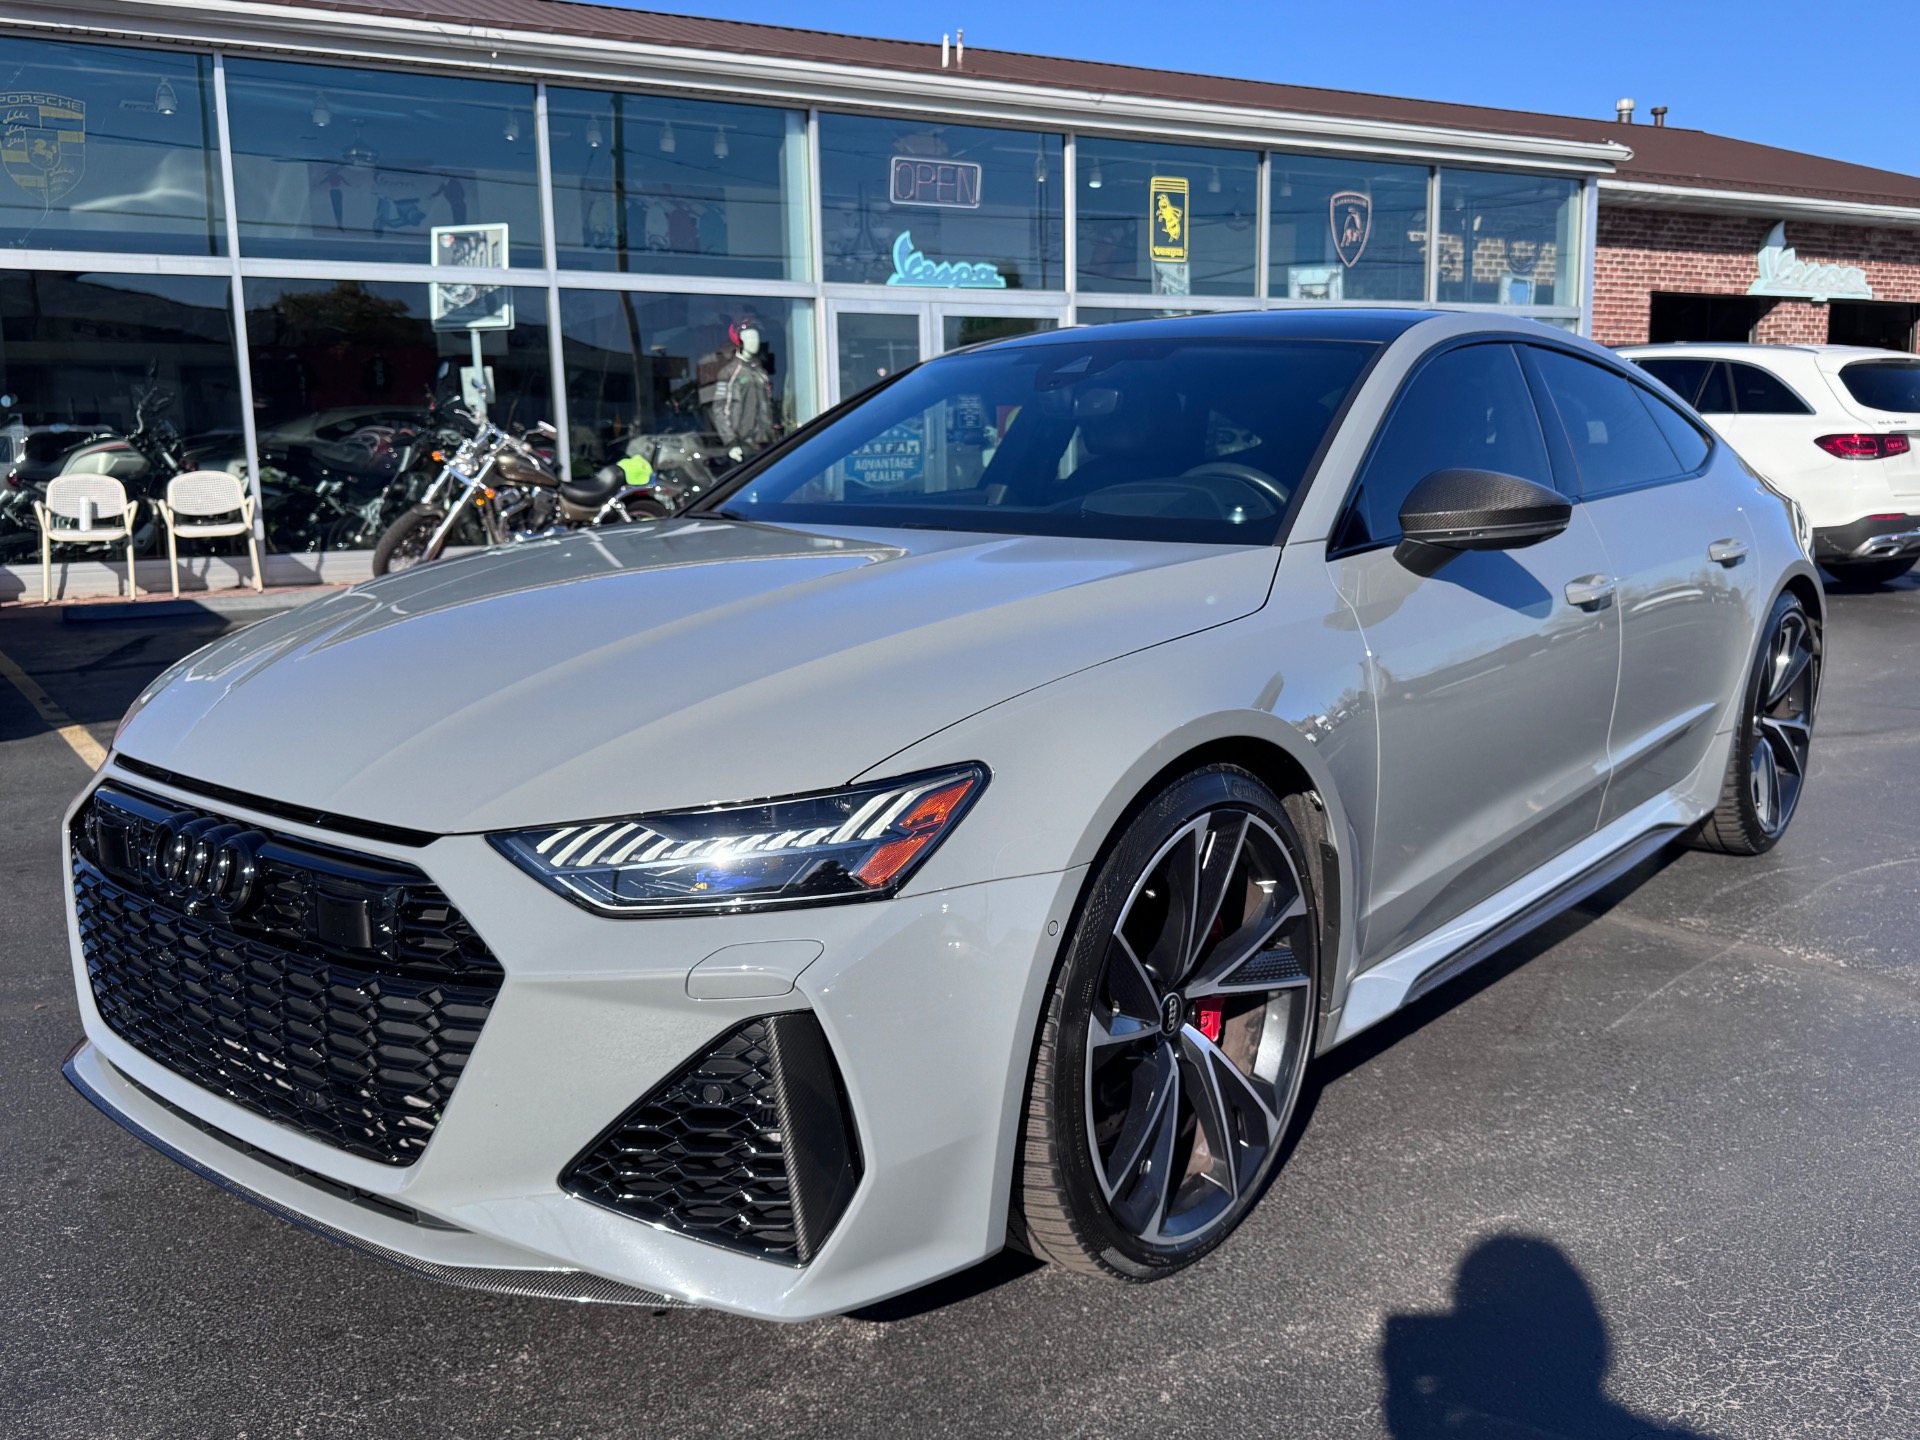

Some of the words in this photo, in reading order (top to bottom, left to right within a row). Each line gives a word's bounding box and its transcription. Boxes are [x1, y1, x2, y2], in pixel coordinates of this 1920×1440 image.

[894, 162, 977, 204] OPEN
[887, 230, 1007, 288] Vespa
[854, 457, 916, 471] ADVANTAGE
[864, 470, 905, 482] DEALER
